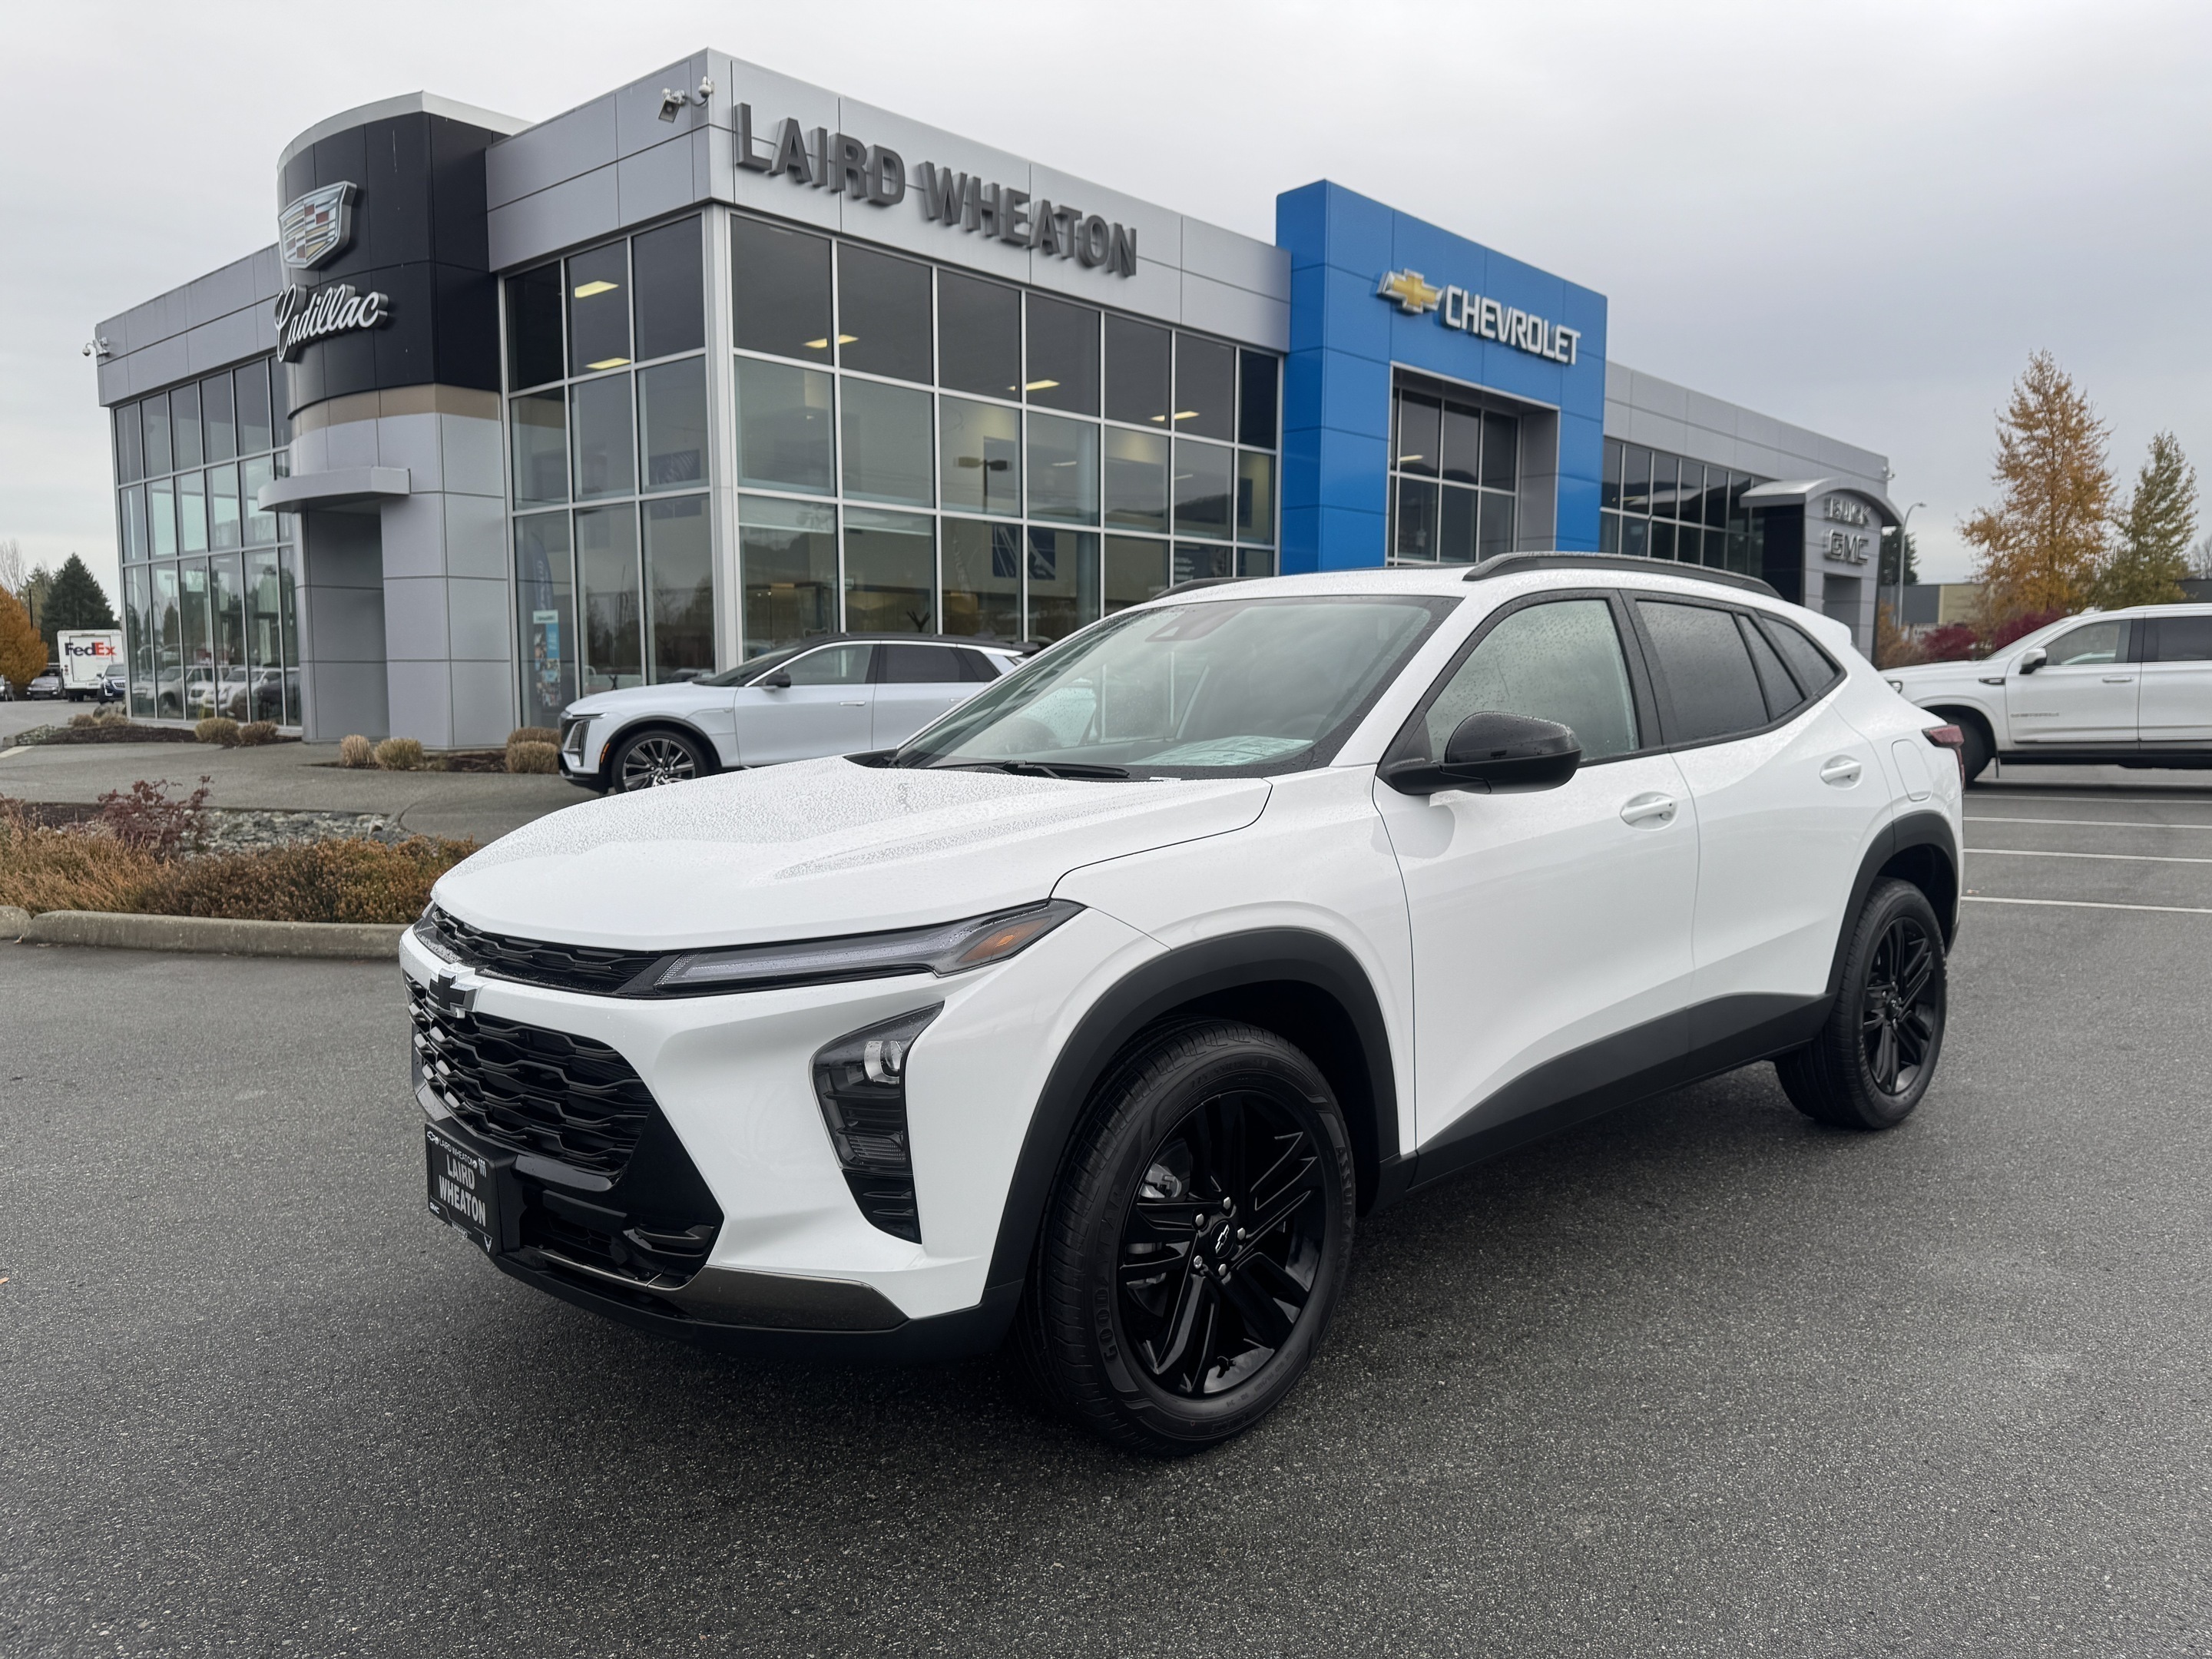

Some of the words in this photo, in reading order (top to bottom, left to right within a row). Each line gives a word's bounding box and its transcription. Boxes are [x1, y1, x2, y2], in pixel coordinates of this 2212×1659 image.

[734, 101, 906, 206] LAIRD
[919, 160, 1137, 277] WHEATON
[274, 283, 386, 363] Cadillac
[1445, 284, 1581, 366] CHEVROLET
[1826, 496, 1872, 525] BUICK
[1826, 528, 1869, 565] GMC
[65, 641, 117, 657] FedEx
[439, 1137, 452, 1153] LAIRD
[451, 1145, 473, 1166] WHEATON
[446, 1154, 475, 1190] LAIRD
[429, 1201, 440, 1215] GMC
[439, 1174, 486, 1227] WHEATON
[1094, 1183, 1124, 1364] GOODYEAR
